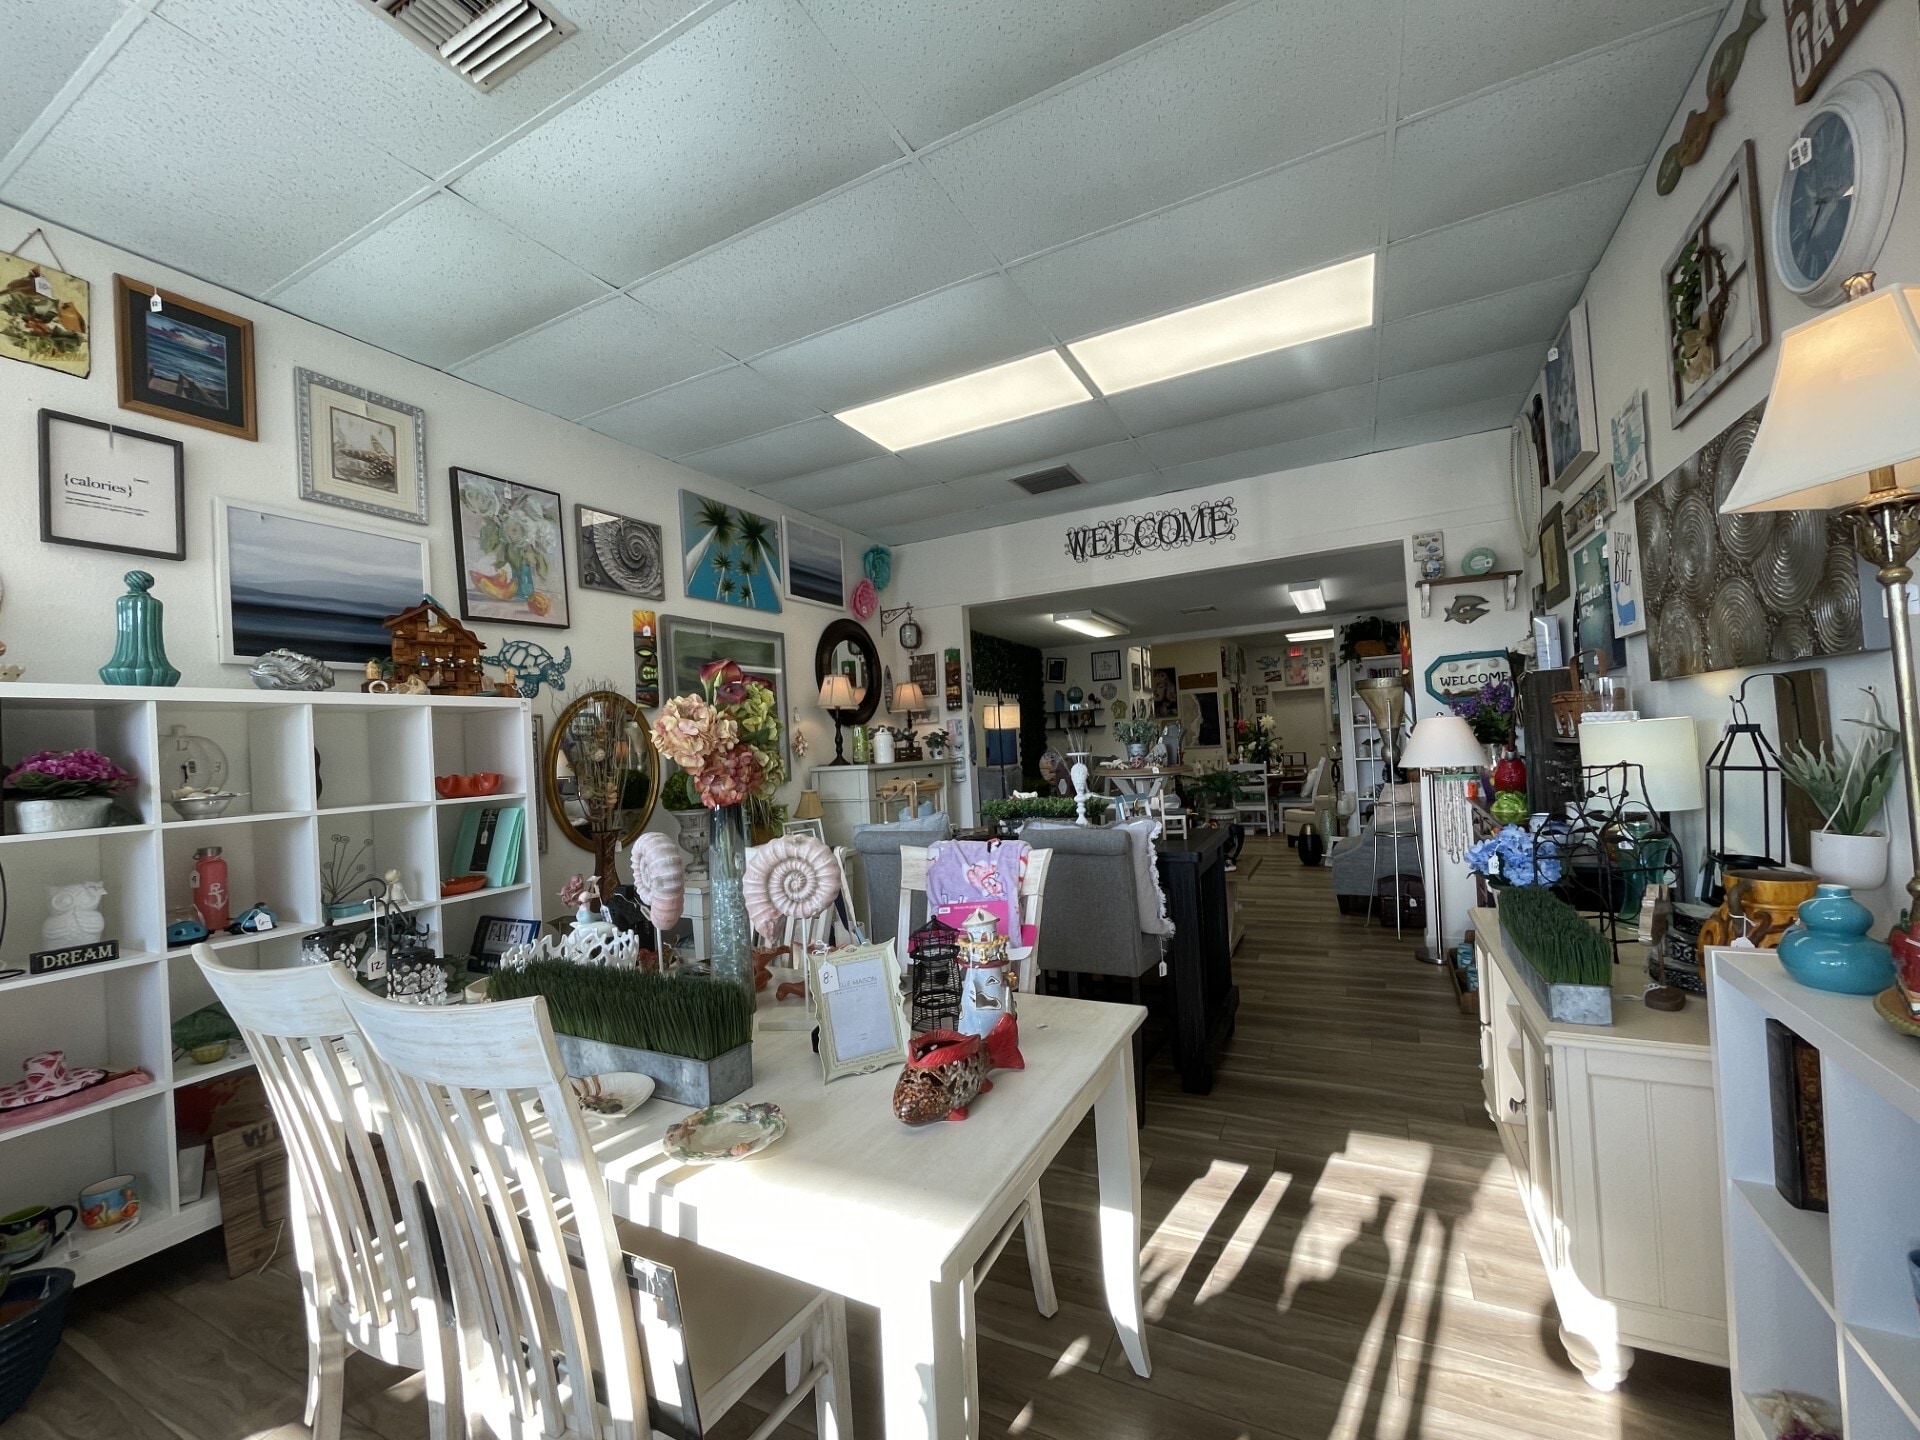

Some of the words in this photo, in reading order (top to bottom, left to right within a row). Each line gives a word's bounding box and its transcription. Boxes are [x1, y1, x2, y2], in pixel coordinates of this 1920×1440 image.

[1065, 499, 1238, 562] WELCOME
[1613, 550, 1633, 586] BIG
[1439, 671, 1509, 687] WELCOME
[488, 921, 529, 944] FAMLY
[42, 944, 114, 969] DREAM
